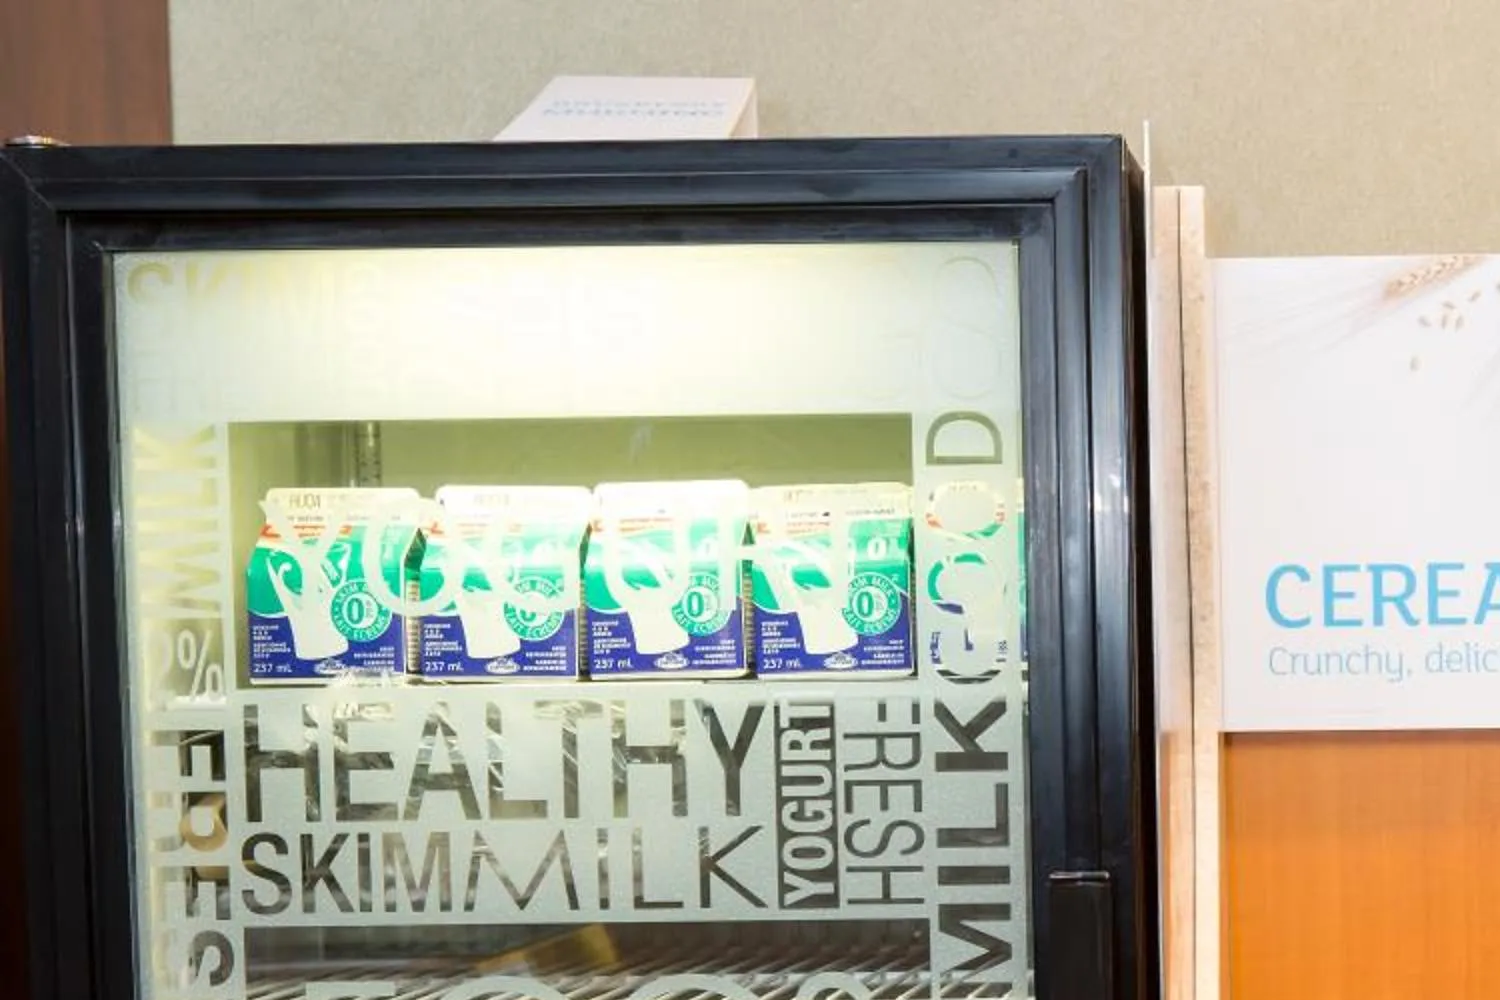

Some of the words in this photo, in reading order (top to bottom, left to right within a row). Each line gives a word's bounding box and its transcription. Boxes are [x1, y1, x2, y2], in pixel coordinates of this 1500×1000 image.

[1267, 644, 1413, 684] Crunchy,
[242, 697, 767, 823] HEALTHY
[781, 699, 836, 907] YOGURT
[843, 701, 925, 905] FRESH
[240, 829, 452, 916] SKIM
[463, 826, 768, 912] MILK
[933, 697, 1012, 998] MILK
